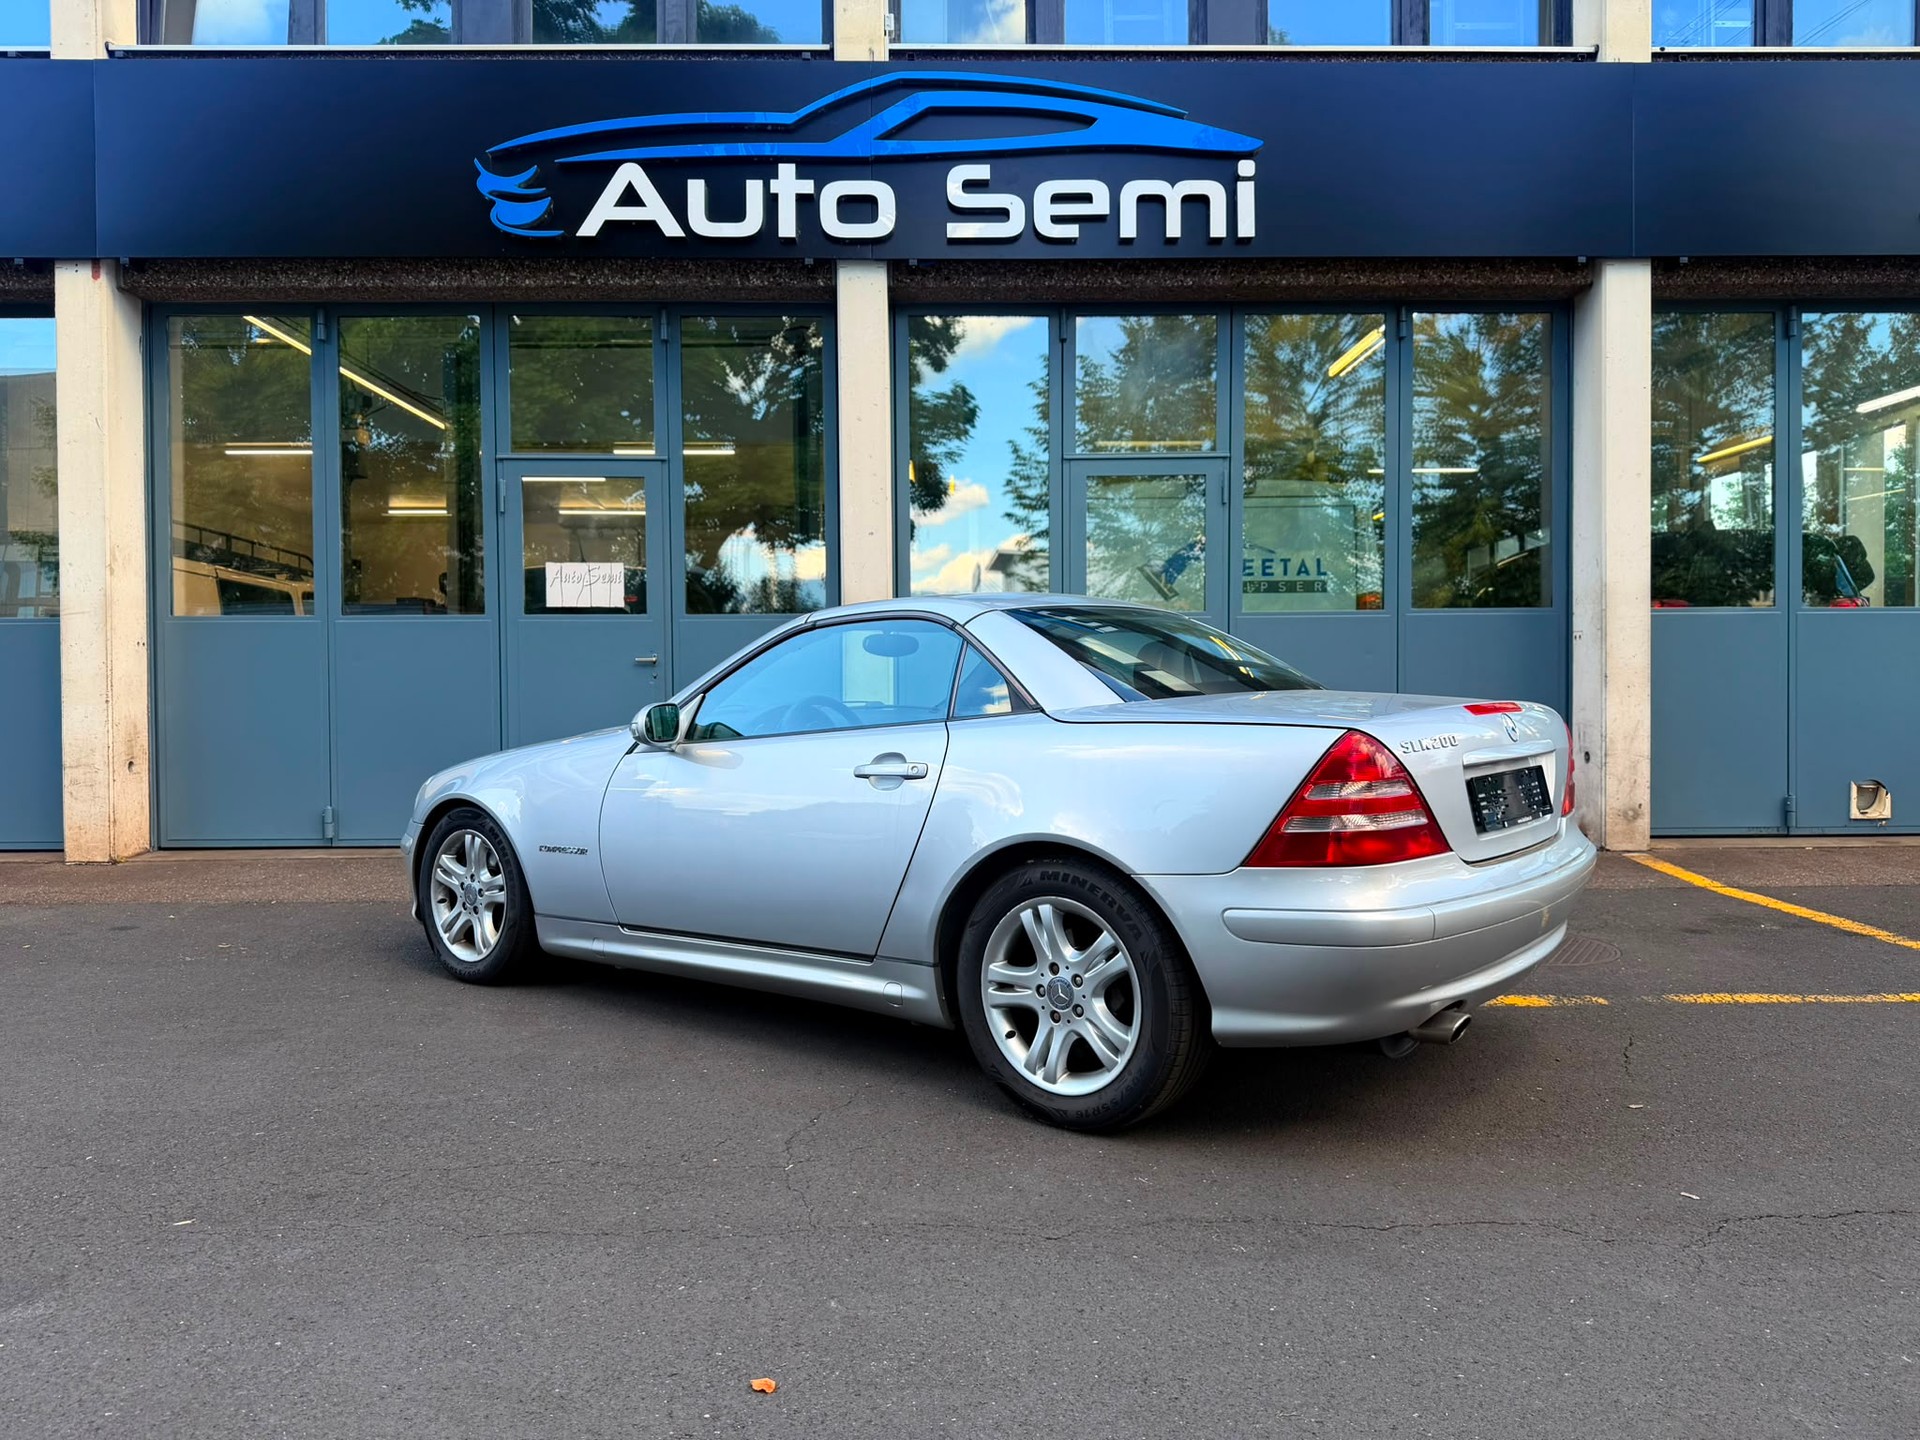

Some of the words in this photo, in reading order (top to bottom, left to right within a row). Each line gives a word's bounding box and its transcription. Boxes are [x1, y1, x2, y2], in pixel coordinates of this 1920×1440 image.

[576, 162, 896, 238] Auto
[946, 159, 1256, 239] Semi
[550, 567, 582, 587] Auto
[583, 565, 622, 587] Semi
[1039, 870, 1142, 941] MINERVA
